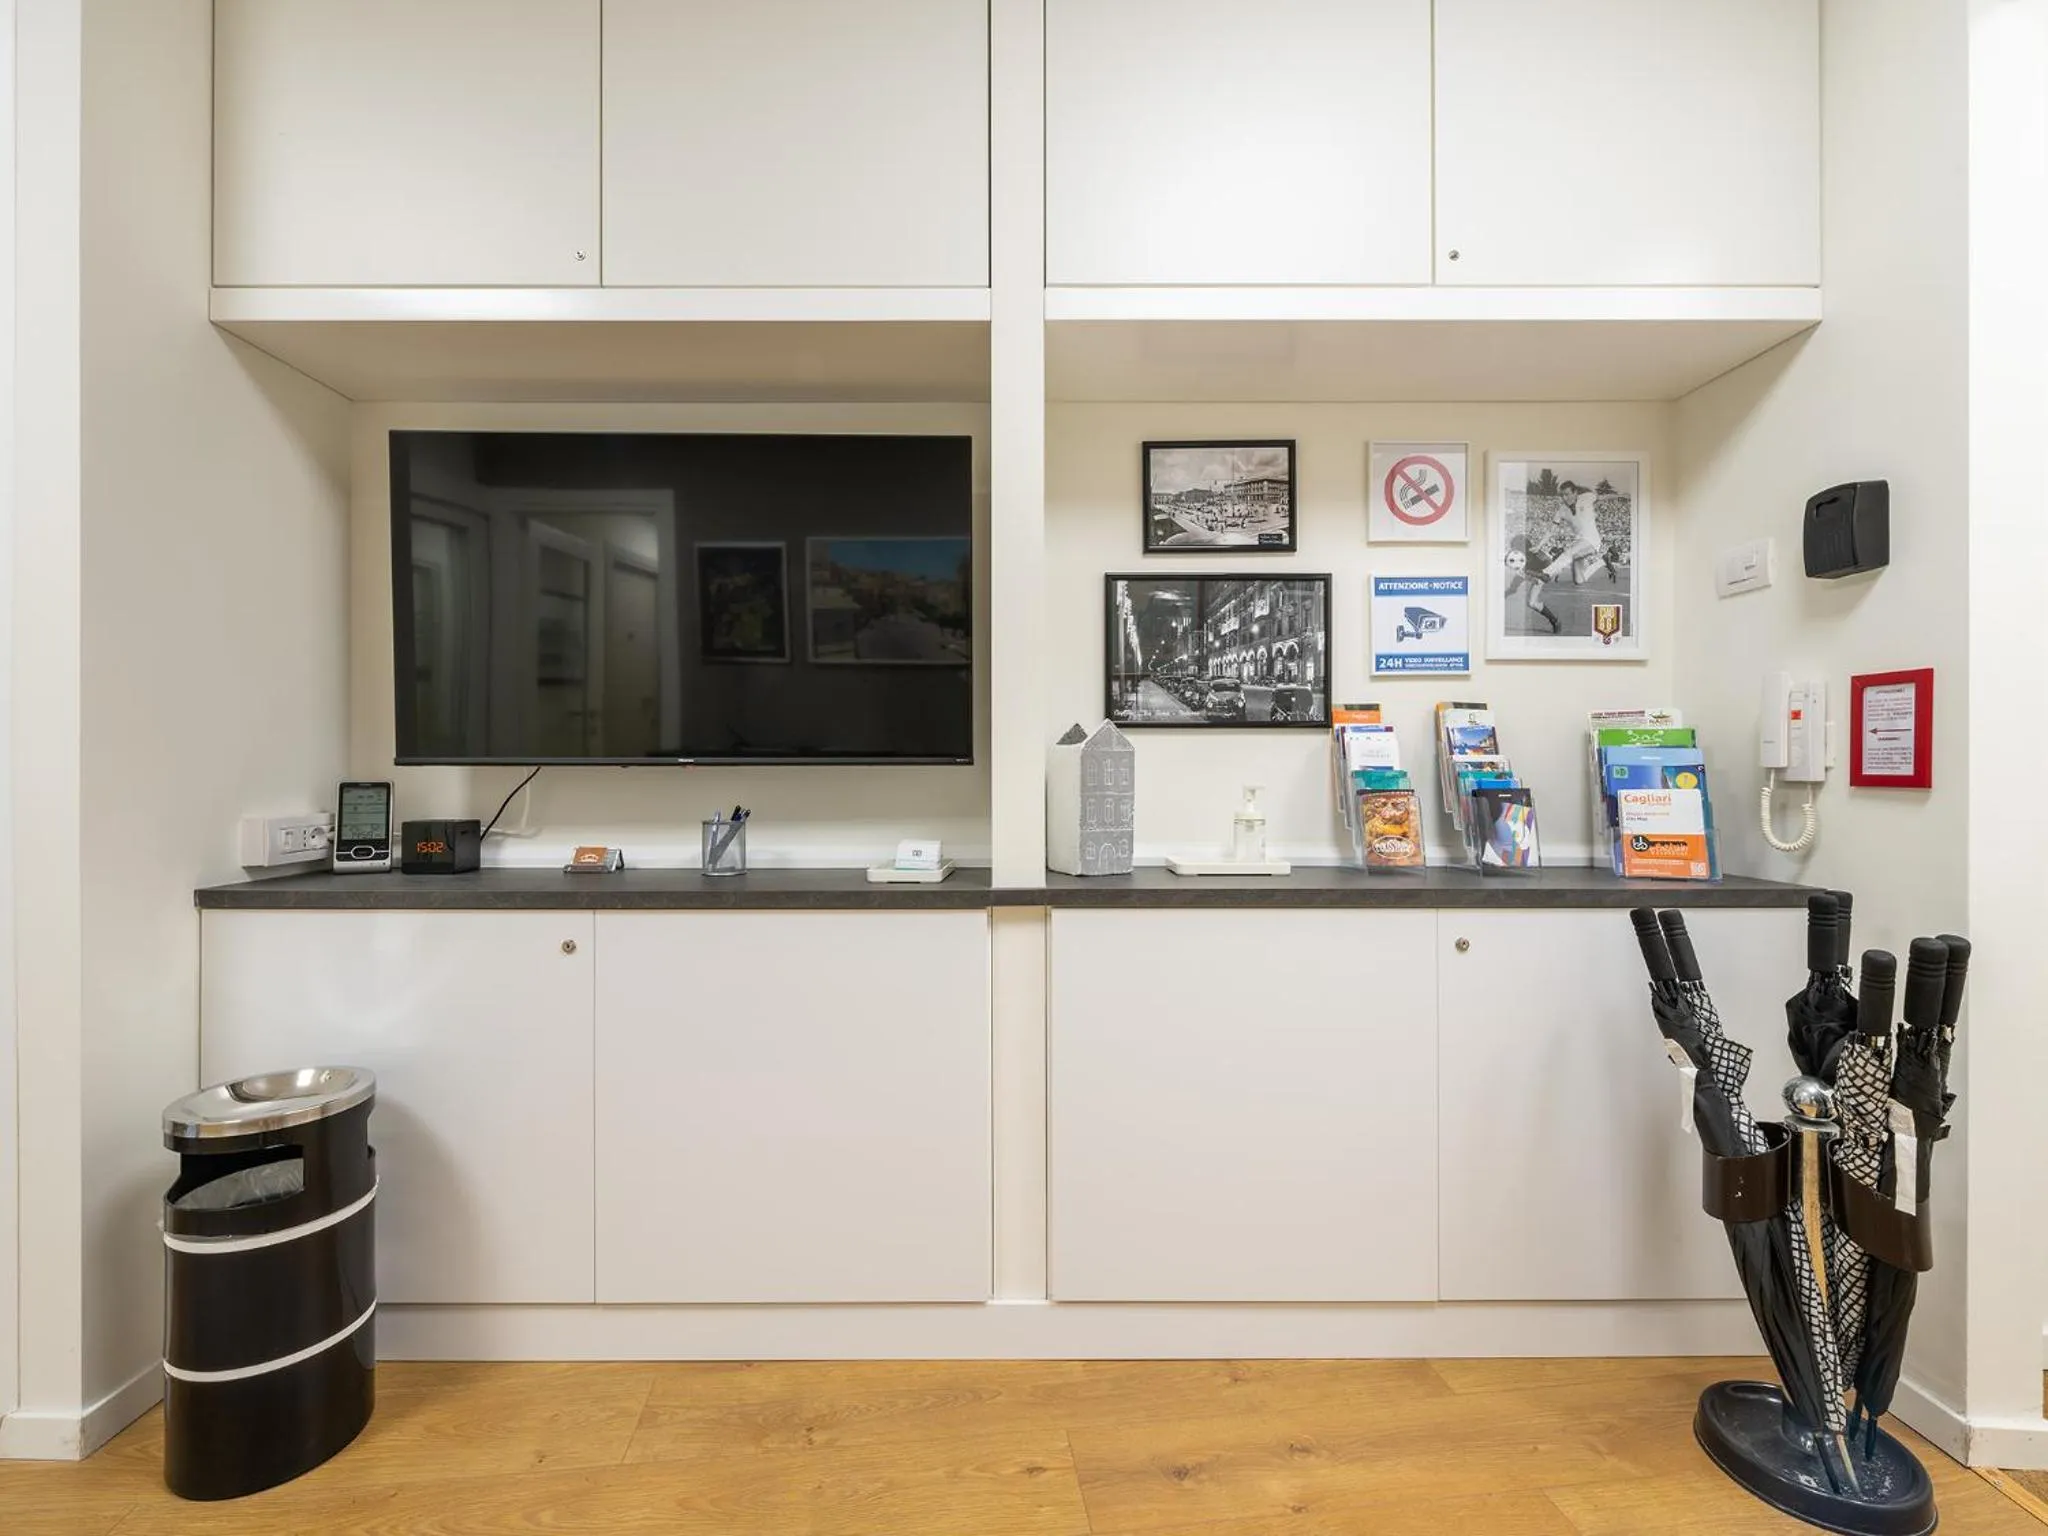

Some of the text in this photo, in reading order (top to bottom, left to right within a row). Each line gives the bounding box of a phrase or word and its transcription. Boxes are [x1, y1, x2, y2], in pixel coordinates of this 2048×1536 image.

[1433, 581, 1463, 590] NOTICE
[1379, 658, 1403, 668] 24H
[1624, 793, 1672, 805] Cagliari
